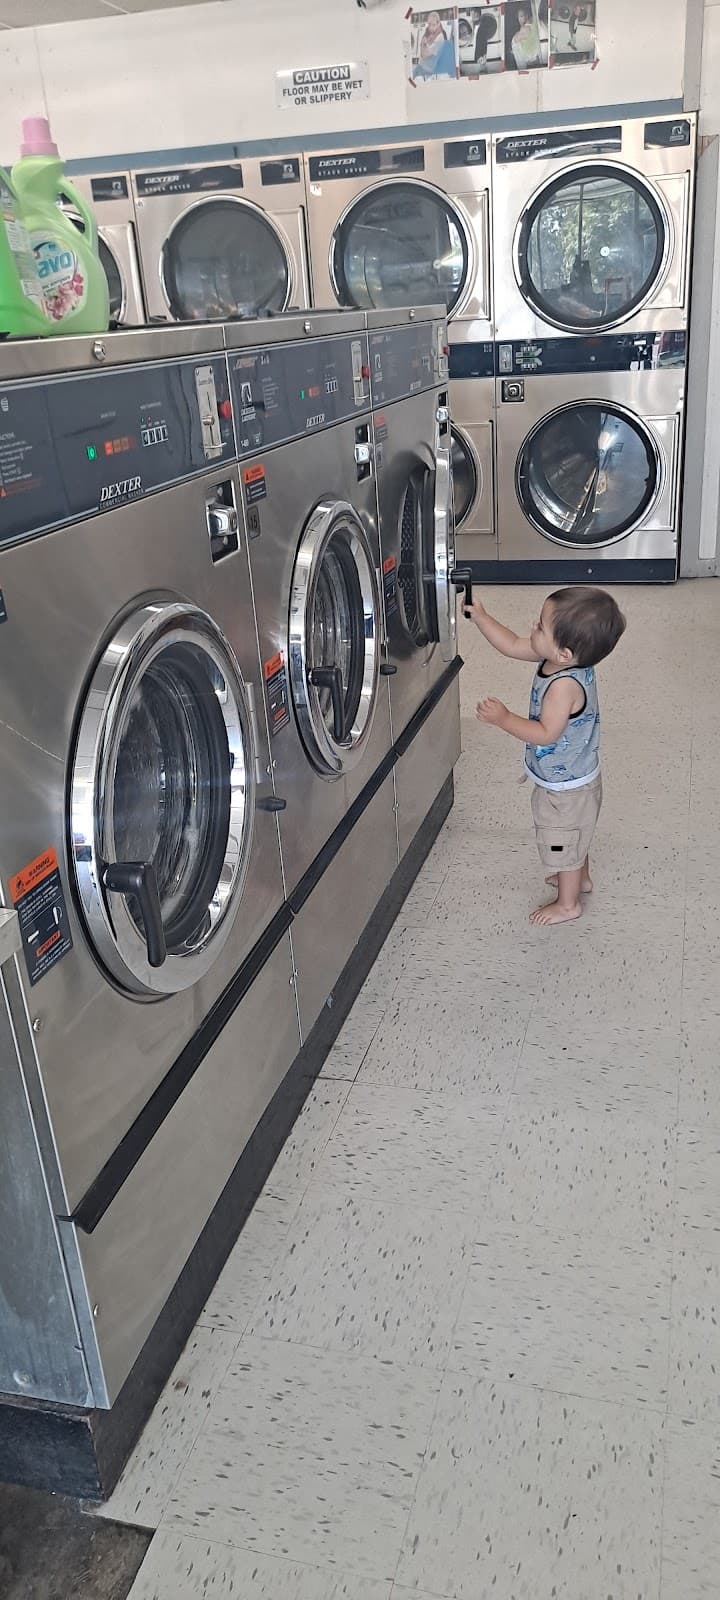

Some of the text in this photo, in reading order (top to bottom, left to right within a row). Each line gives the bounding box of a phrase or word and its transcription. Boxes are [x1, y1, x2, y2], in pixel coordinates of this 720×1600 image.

[295, 66, 349, 83] CAUTION
[282, 80, 363, 96] FLOOR MAY BE WET
[294, 91, 352, 106] OR SLIPPERY
[506, 138, 547, 148] DEXTER
[318, 157, 356, 167] DEXTER
[144, 174, 180, 185] DEXTER
[306, 413, 325, 428] DEXTER
[100, 476, 142, 502] DEXTER
[28, 856, 50, 876] WARNING
